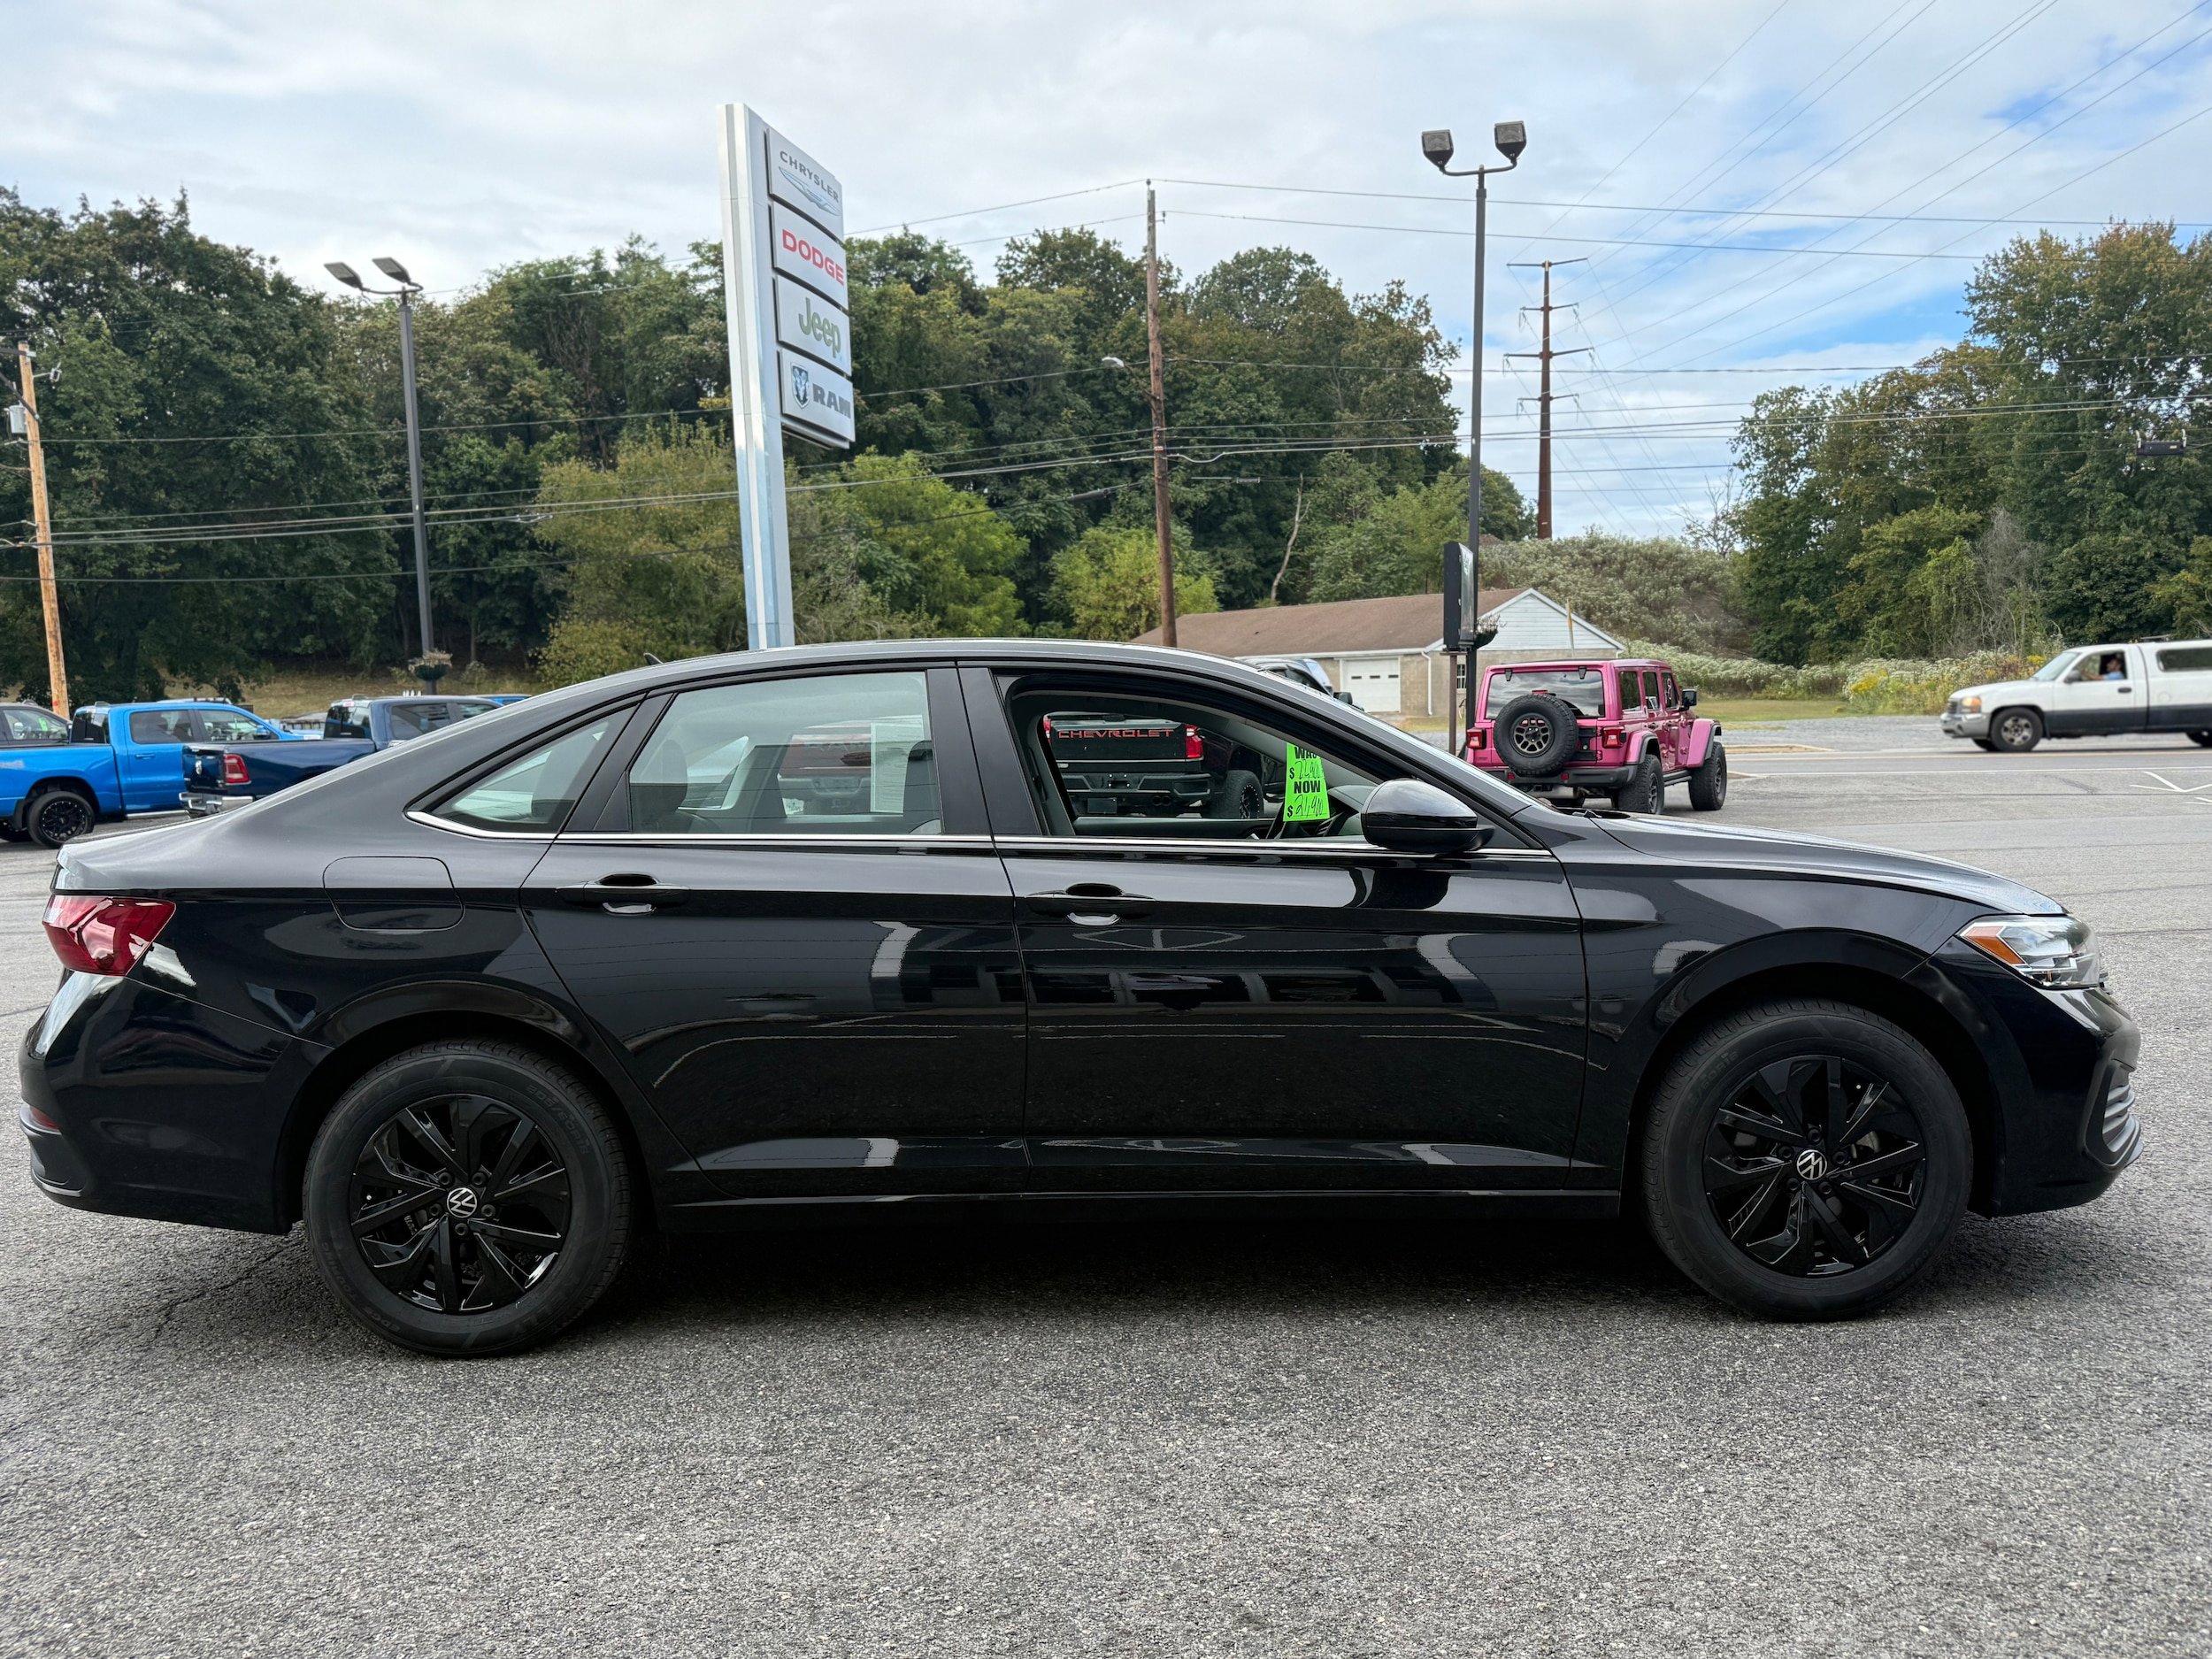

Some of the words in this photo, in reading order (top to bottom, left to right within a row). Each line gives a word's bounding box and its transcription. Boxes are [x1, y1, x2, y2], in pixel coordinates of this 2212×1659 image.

[780, 150, 839, 203] CHRYSLER
[782, 228, 844, 286] DODGE
[798, 296, 841, 358] Jeep
[812, 382, 851, 419] RAM
[1058, 729, 1174, 738] CHEVROLET
[1294, 780, 1321, 794] NOW
